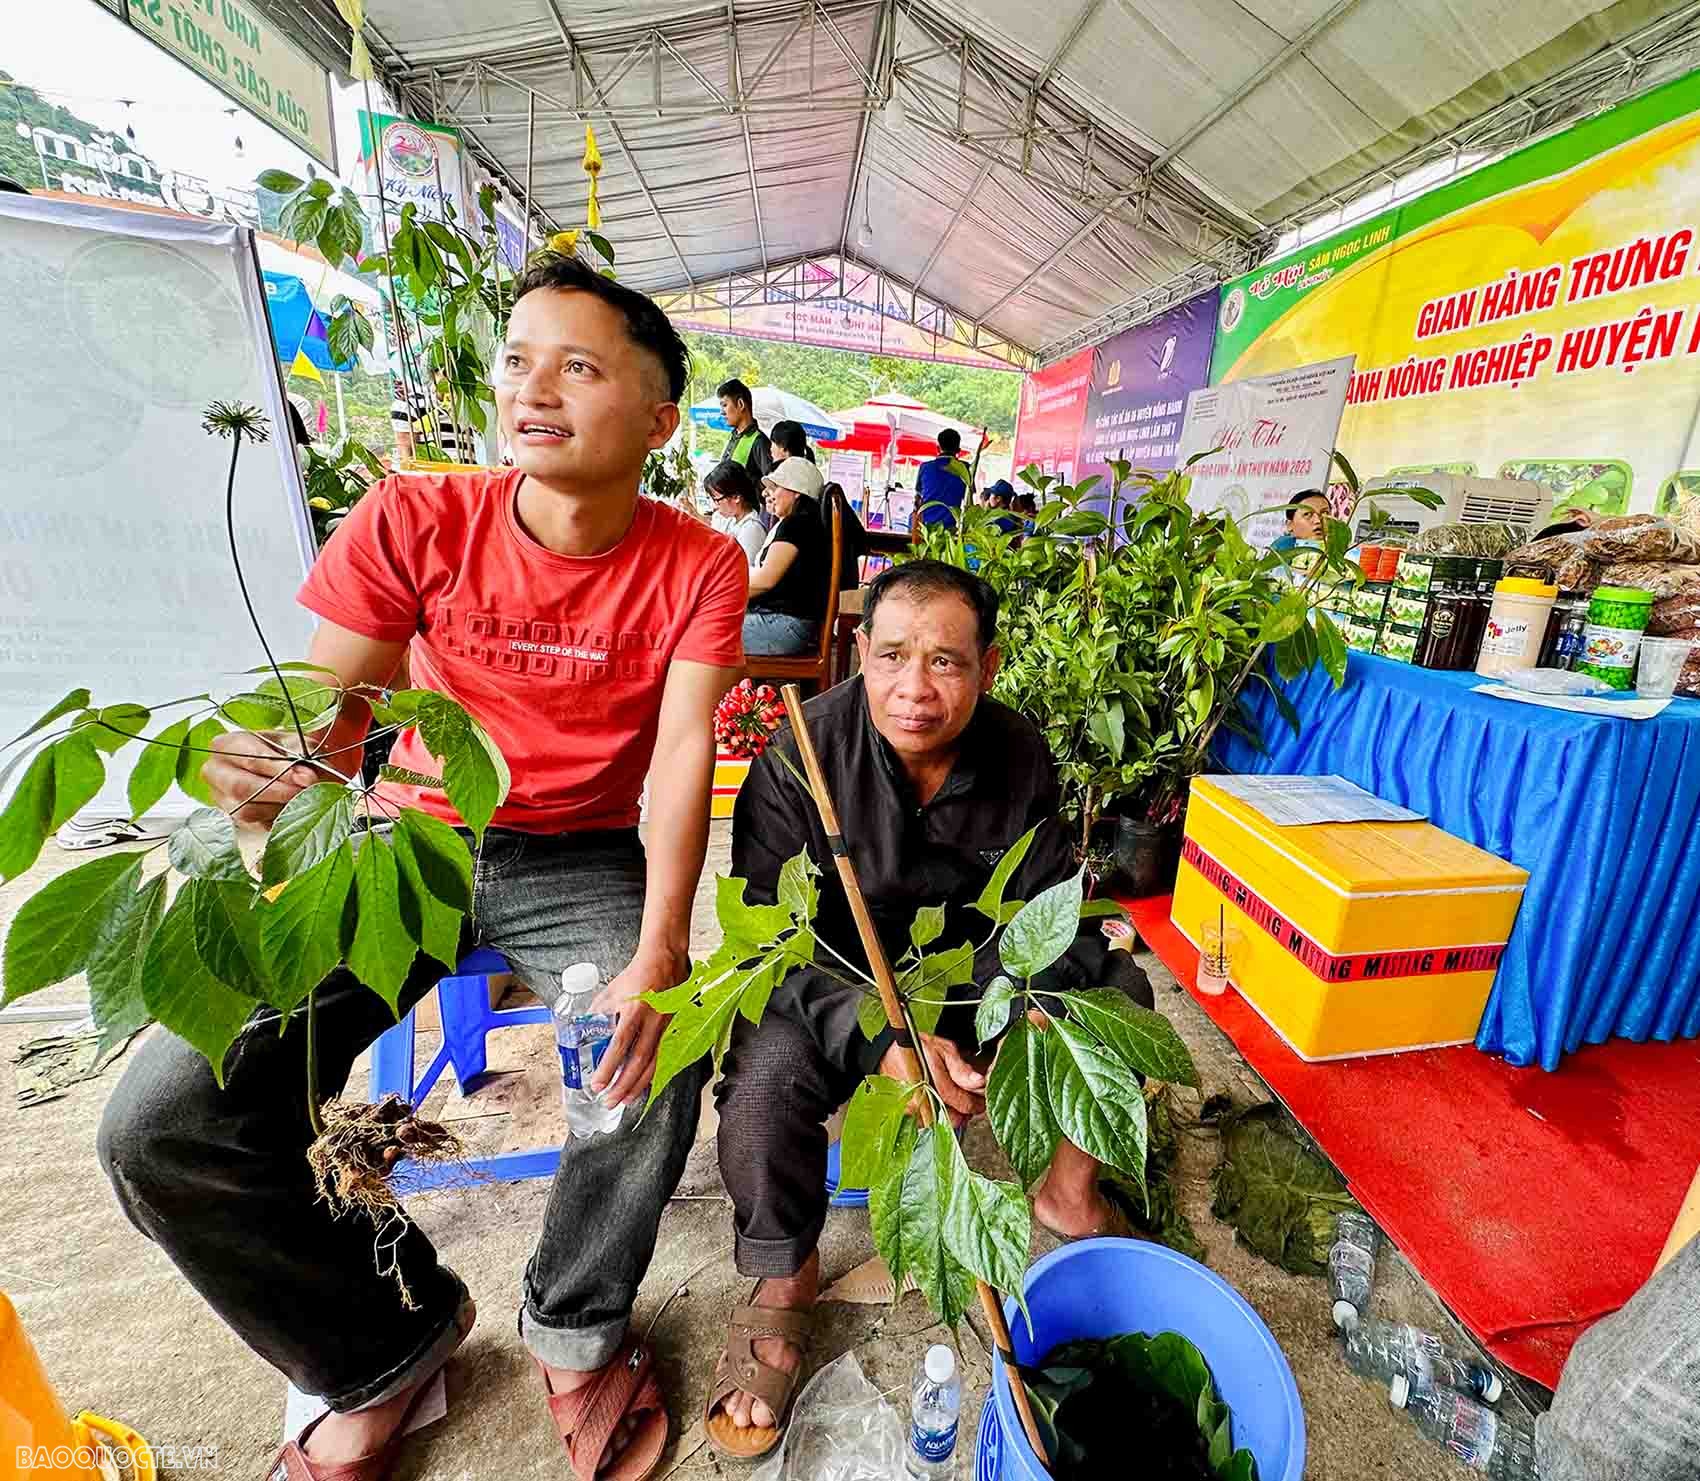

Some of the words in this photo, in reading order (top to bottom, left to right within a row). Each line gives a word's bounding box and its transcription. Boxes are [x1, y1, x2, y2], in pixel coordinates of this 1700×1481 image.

[1363, 226, 1391, 249] LINH
[1416, 291, 1474, 338] GIAN
[1478, 268, 1561, 323] HÀNG
[1567, 228, 1693, 302] TRƯNG
[1383, 358, 1449, 400] NÔNG
[1453, 333, 1552, 394] NGHIỆP
[1556, 308, 1684, 374] HUYỆN
[1250, 417, 1287, 447] Thi
[511, 641, 539, 652] EVERY
[540, 644, 561, 654] STEP
[561, 647, 573, 656] OF
[574, 648, 589, 658] THE
[589, 650, 608, 660] WAY
